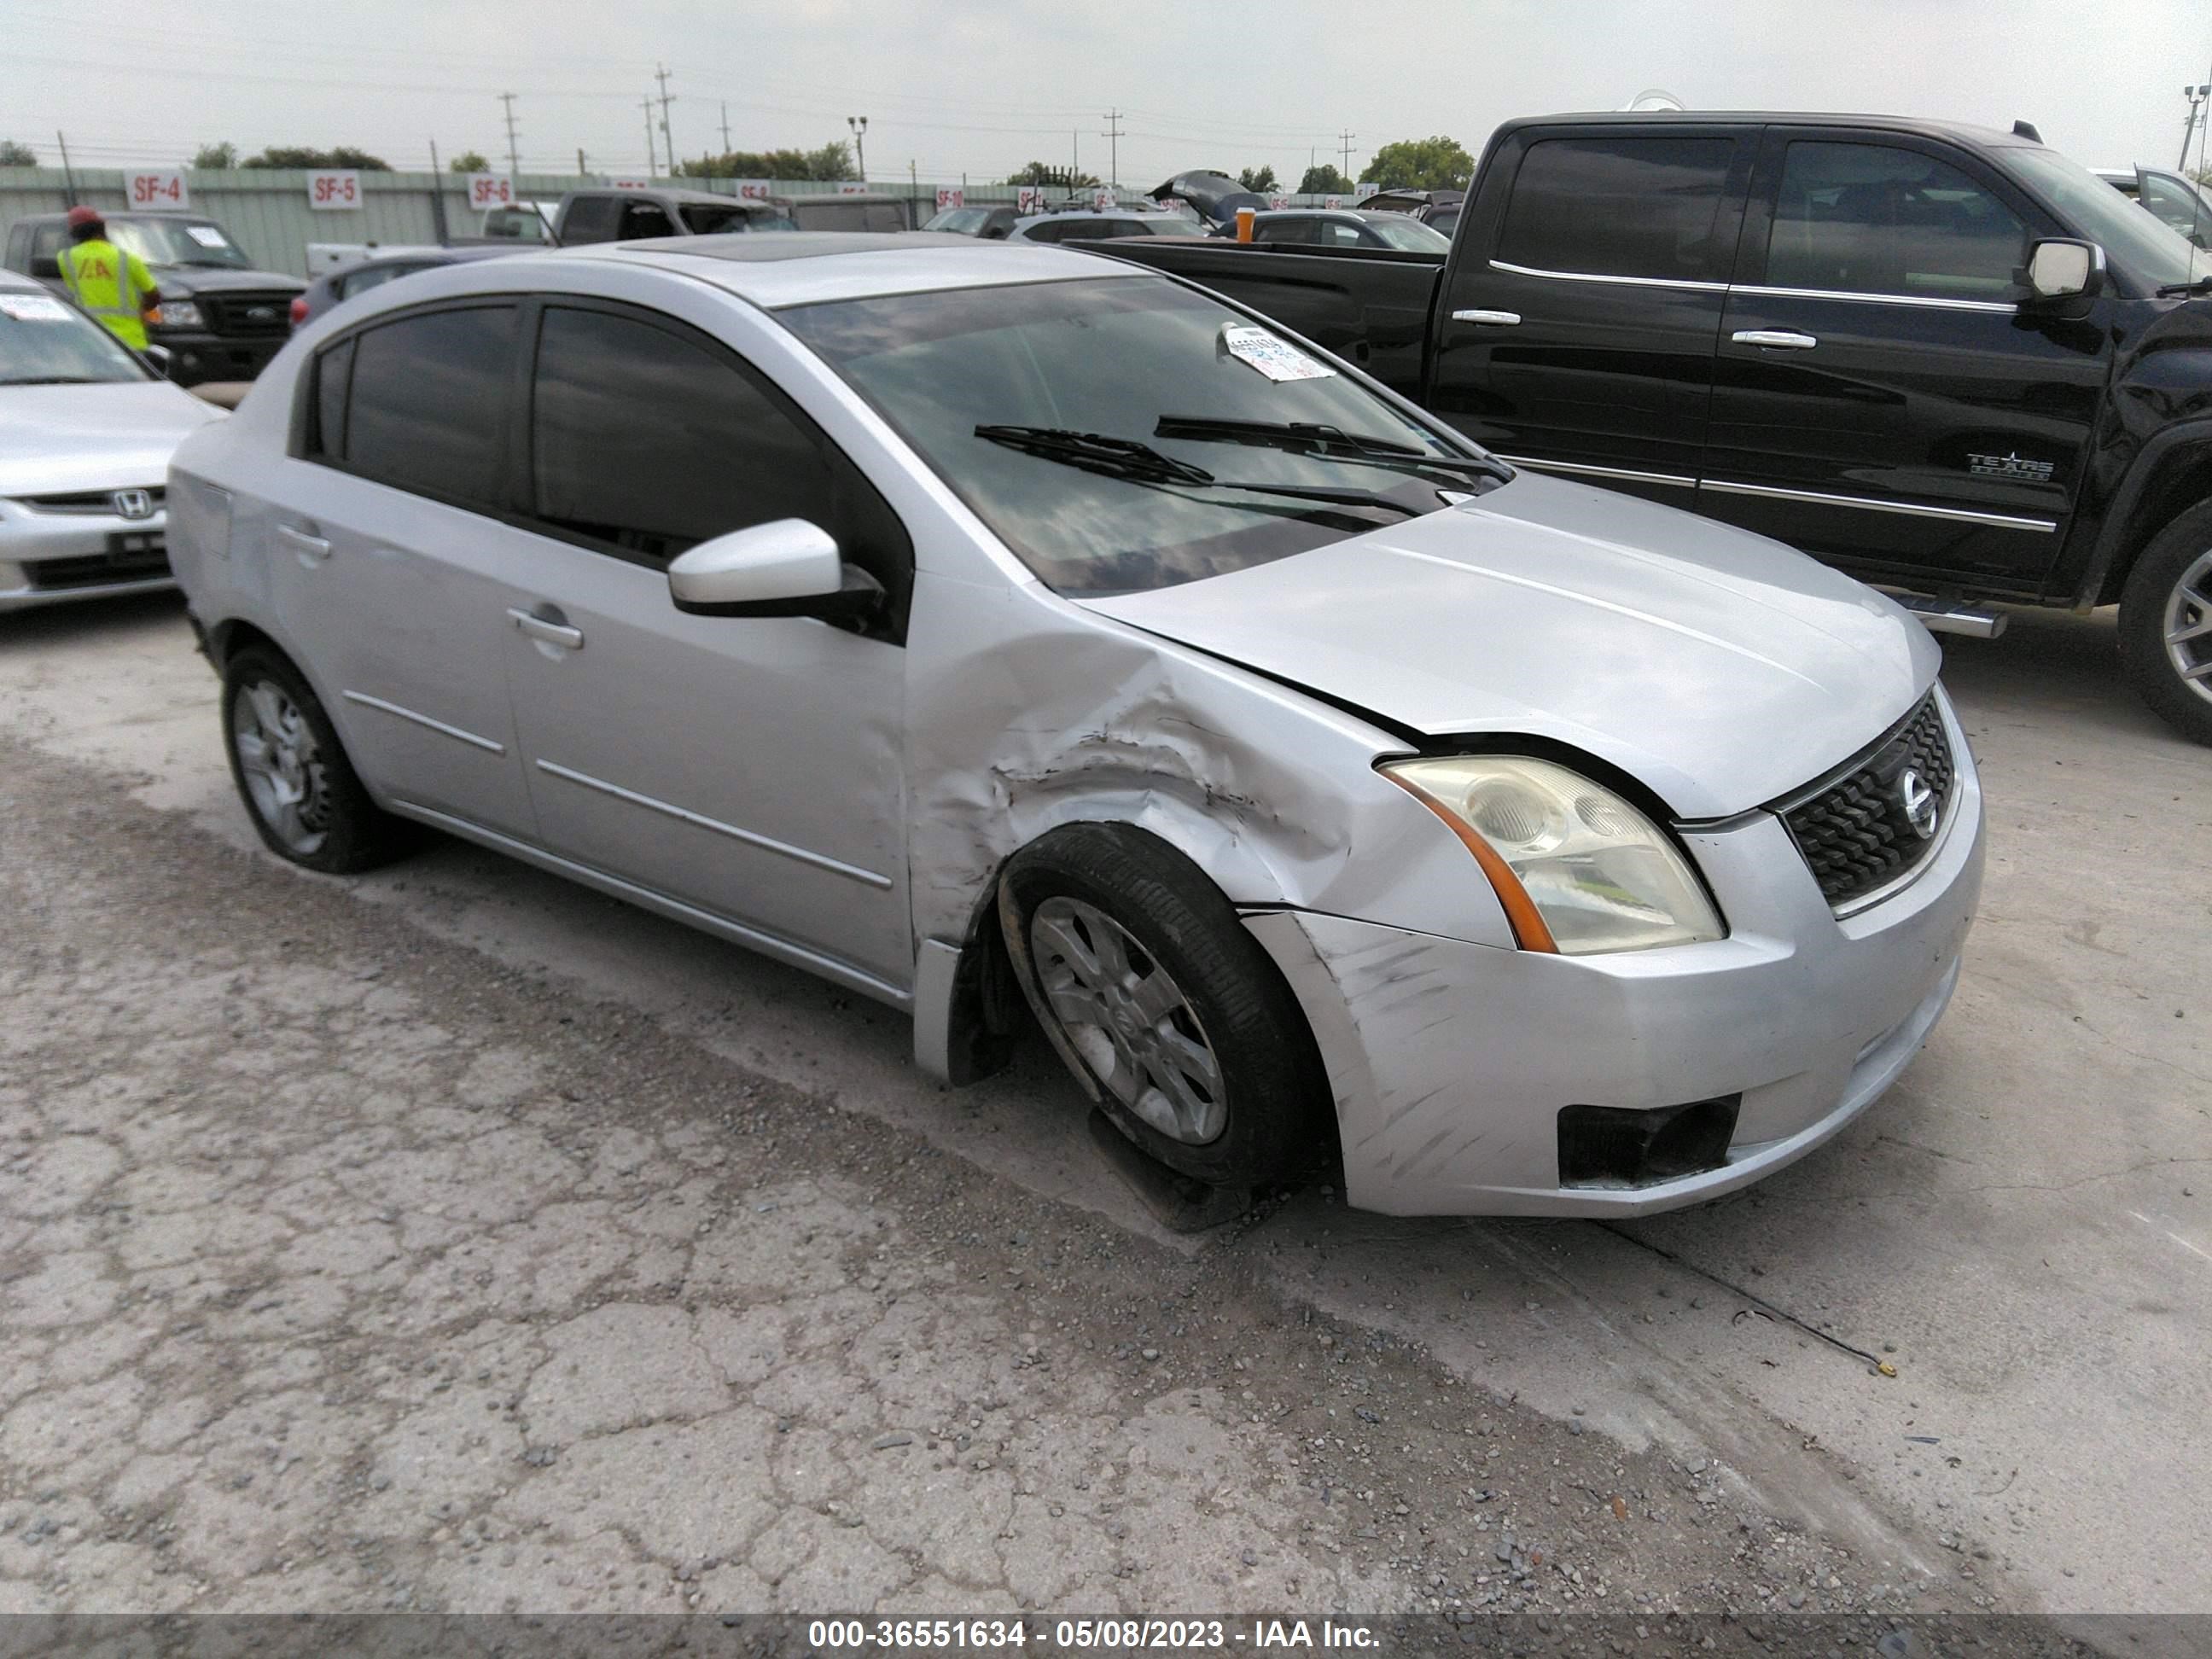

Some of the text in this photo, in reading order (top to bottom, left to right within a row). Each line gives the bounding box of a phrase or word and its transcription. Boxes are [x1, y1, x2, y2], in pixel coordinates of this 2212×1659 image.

[134, 176, 179, 201] SF-4
[315, 177, 355, 201] SF-5
[474, 178, 509, 201] SF-6
[1967, 452, 2054, 473] TEXAS
